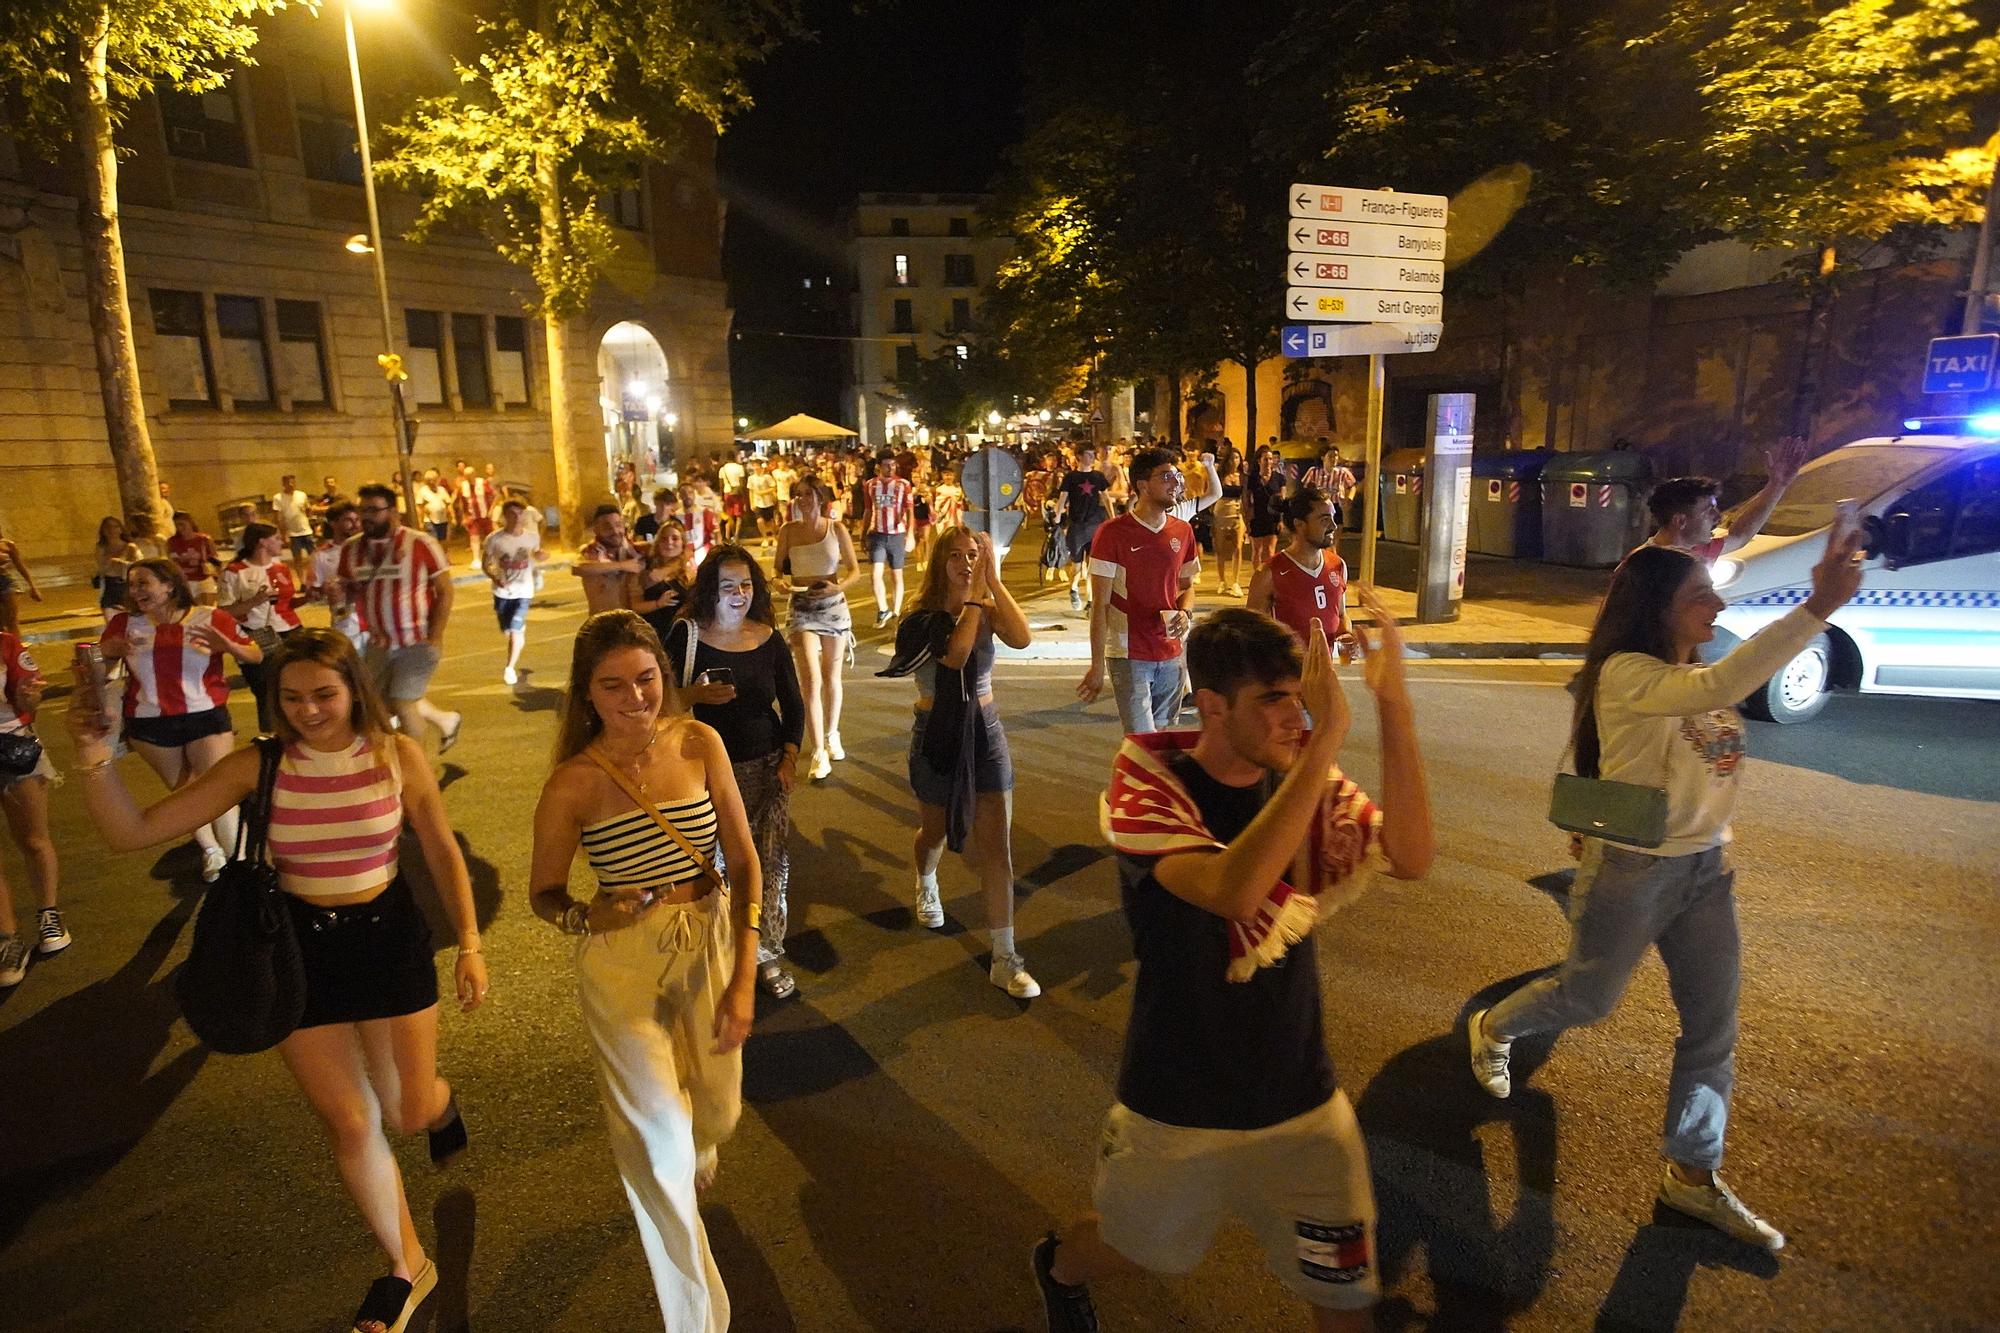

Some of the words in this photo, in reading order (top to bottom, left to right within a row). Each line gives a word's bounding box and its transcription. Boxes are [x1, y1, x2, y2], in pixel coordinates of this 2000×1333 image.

[1361, 198, 1443, 219] França-Figueres
[1318, 232, 1347, 244] C-66
[1398, 235, 1442, 253] Banyoles
[1317, 266, 1347, 279] C-66
[1400, 268, 1440, 284] Palamós
[1378, 300, 1401, 314] Sant
[1403, 301, 1439, 317] Gregori
[1315, 335, 1324, 347] P
[1404, 331, 1437, 347] Jutjats
[1932, 355, 1988, 374] TAXI
[1314, 585, 1327, 609] 6
